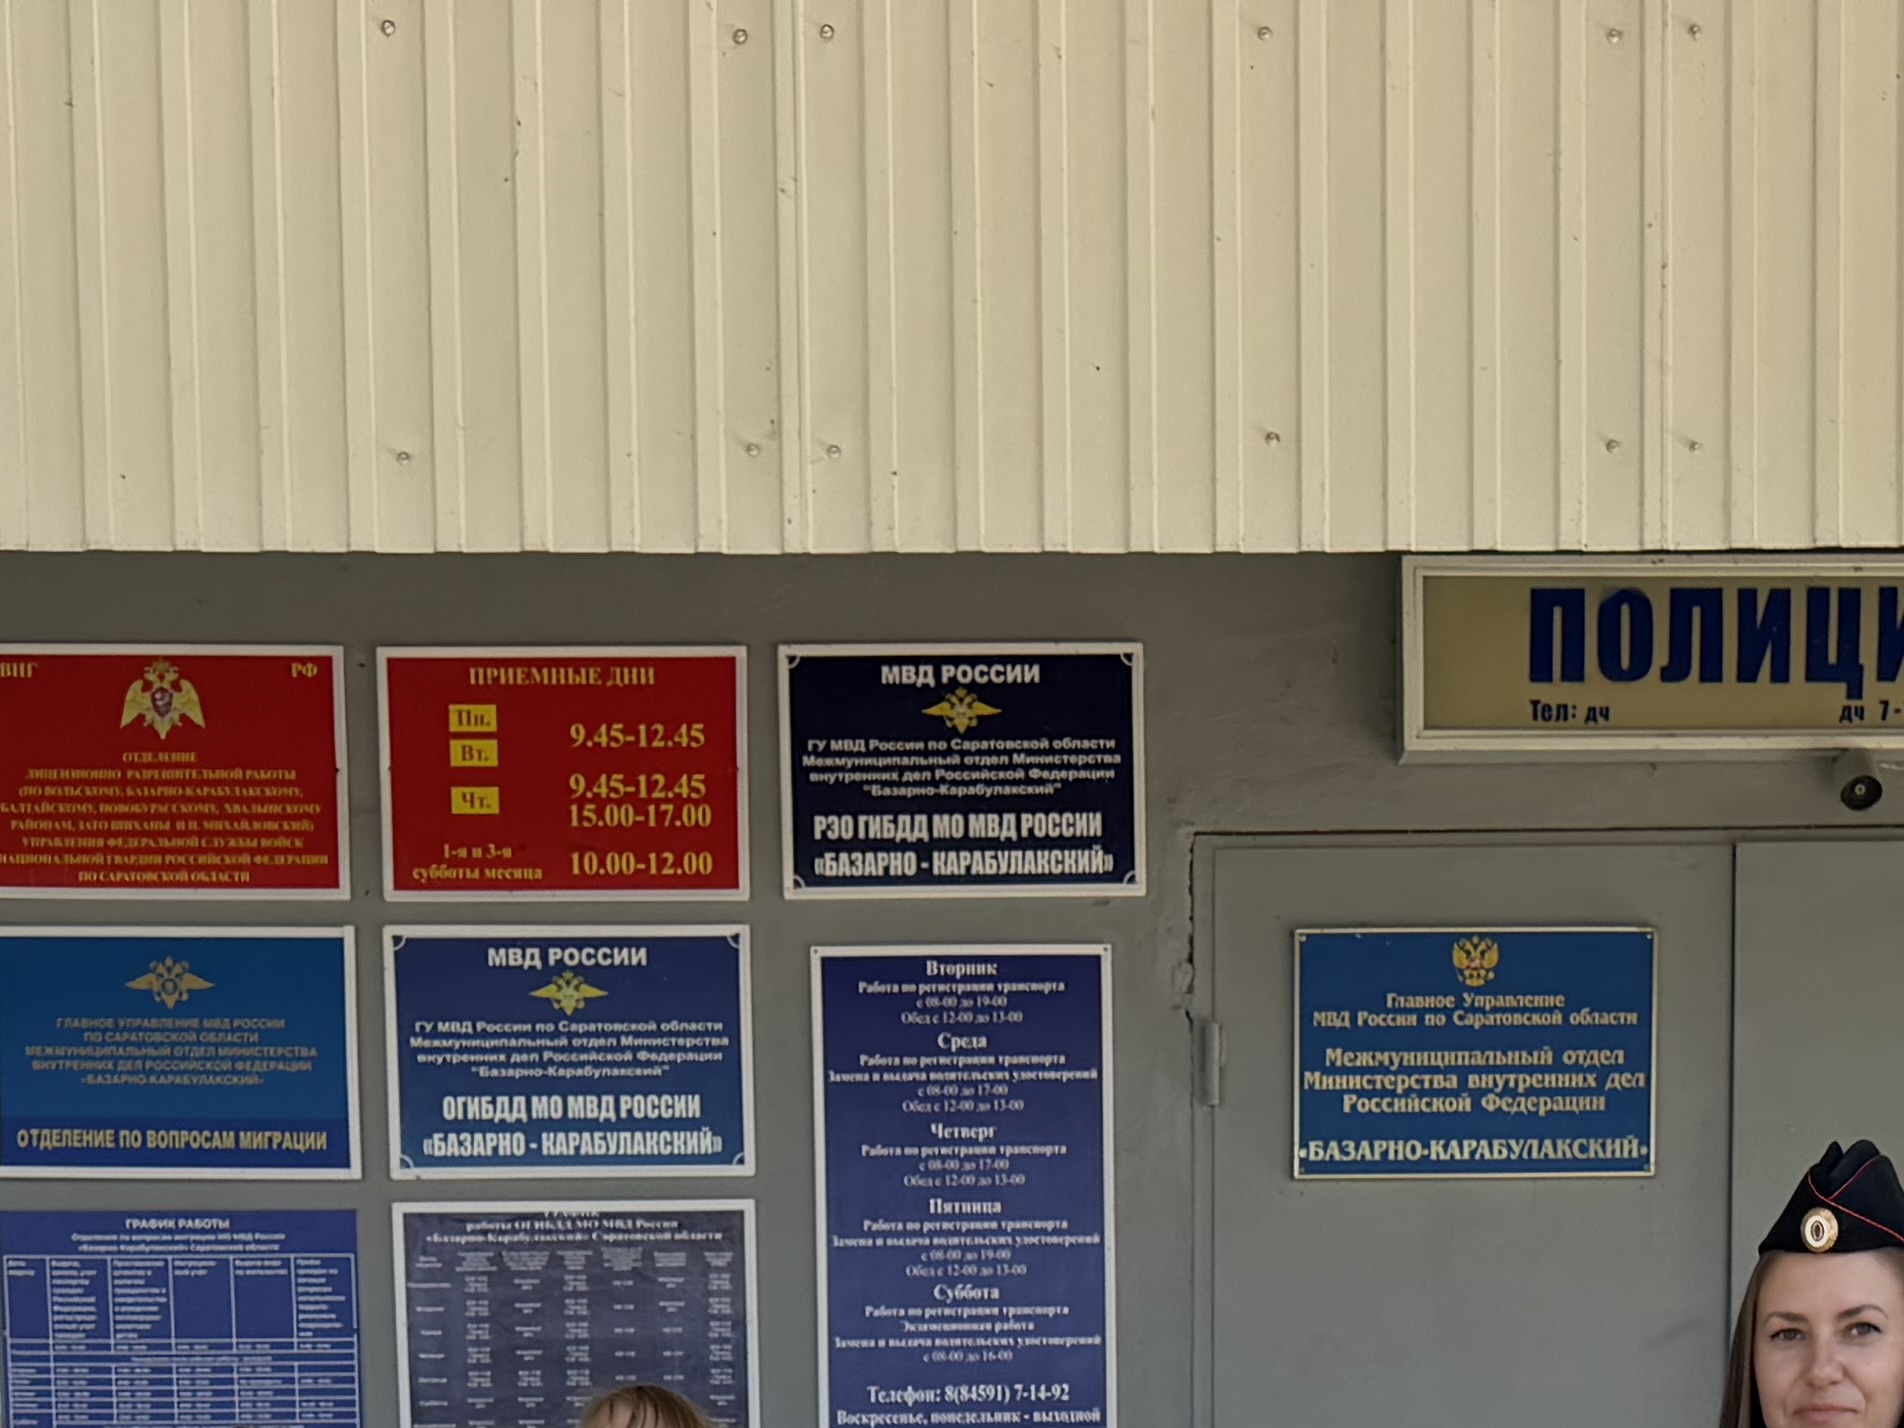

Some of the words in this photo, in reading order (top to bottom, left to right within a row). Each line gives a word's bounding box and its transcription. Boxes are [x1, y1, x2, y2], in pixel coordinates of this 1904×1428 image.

[0, 662, 37, 678] ВНГ
[291, 663, 318, 678] РФ
[470, 667, 601, 686] ПРИЕМНЫЕ
[607, 667, 655, 688] ДНИ
[882, 665, 935, 688] МВД
[942, 664, 1040, 683] РОССИИ
[457, 709, 491, 727] Пн.
[1530, 699, 1577, 722] Тел:
[1585, 705, 1609, 725] дч
[1840, 704, 1864, 725] дч
[570, 723, 705, 748] 9.45-12.45
[808, 740, 828, 752] ГУ
[831, 740, 865, 753] МВД
[869, 739, 924, 752] России
[928, 741, 947, 752] по
[951, 737, 1049, 752] Саратовской
[1053, 737, 1116, 751] области
[461, 745, 490, 762] Вт.
[802, 755, 961, 767] Межмуниципальный
[964, 755, 1009, 767] отдел
[1013, 752, 1121, 766] Министерства
[810, 770, 899, 783] внутренних
[902, 770, 932, 783] дел
[935, 768, 1025, 781] Российской
[1029, 768, 1115, 783] Федерации
[569, 773, 706, 798] 9.45-12.45
[461, 792, 491, 809] Чт.
[570, 804, 712, 827] 15.00-17.00
[814, 816, 854, 840] РЭО
[858, 814, 929, 842] ГИБДД
[933, 814, 964, 839] МО
[969, 814, 1017, 841] МВД
[1021, 812, 1102, 838] РОССИИ
[571, 852, 713, 875] 10.00-12.00
[815, 852, 916, 877] «БАЗАРНО
[933, 846, 1113, 875] КАРАБУЛАКСКИЙ»
[413, 864, 479, 883] субботы
[485, 867, 542, 880] месяца
[488, 948, 542, 969] МВД
[549, 947, 647, 966] РОССИИ
[926, 960, 997, 978] Вторник
[1386, 994, 1455, 1008] Главное
[1462, 993, 1565, 1010] Управление
[56, 1018, 114, 1029] ГЛАВНОЕ
[118, 1018, 200, 1029] УПРАВЛЕНИЕ
[204, 1018, 230, 1029] МВД
[233, 1018, 285, 1029] РОССИИ
[415, 1022, 434, 1033] ГУ
[438, 1022, 473, 1034] МВД
[477, 1021, 531, 1032] России
[536, 1023, 554, 1033] по
[558, 1021, 656, 1033] Саратовской
[661, 1020, 723, 1032] области
[1313, 1012, 1350, 1028] МВД
[1357, 1011, 1417, 1027] России
[1425, 1014, 1445, 1026] по
[1453, 1010, 1562, 1029] Саратовской
[1569, 1008, 1637, 1025] области
[84, 1032, 101, 1043] ПО
[104, 1032, 197, 1043] САРАТОВСКОЙ
[200, 1032, 259, 1043] ОБЛАСТИ
[410, 1037, 568, 1049] Межмуниципальный
[572, 1037, 616, 1048] отдел
[621, 1036, 729, 1048] Министерства
[937, 1032, 987, 1051] Среда
[25, 1046, 170, 1057] МЕЖМУНИЦИПАЛЬНЫЙ
[174, 1046, 216, 1057] ОТДЕЛ
[219, 1046, 317, 1057] МИНИСТЕРСТВА
[417, 1052, 506, 1064] внутренних
[510, 1052, 538, 1063] дел
[544, 1050, 632, 1062] Российской
[637, 1050, 723, 1063] Федерации
[1325, 1047, 1552, 1069] Межмуниципальный
[1563, 1049, 1624, 1066] отдел
[33, 1060, 114, 1071] ВНУТРЕННИХ
[117, 1060, 142, 1071] ДЕЛ
[145, 1060, 232, 1071] РОССИЙСКОЙ
[235, 1060, 312, 1071] ФЕДЕРАЦИИ
[1304, 1073, 1457, 1093] Министерства
[1468, 1074, 1596, 1092] внутренних
[1605, 1073, 1645, 1091] дел
[443, 1096, 527, 1123] ОГИБДД
[532, 1096, 562, 1119] МО
[567, 1095, 616, 1122] МВД
[621, 1094, 700, 1119] РОССИИ
[1343, 1094, 1472, 1113] Российской
[1481, 1095, 1605, 1116] Федерации
[17, 1129, 114, 1150] ОТДЕЛЕНИЕ
[120, 1130, 142, 1149] ПО
[146, 1130, 235, 1150] ВОПРОСАМ
[240, 1131, 327, 1152] МИГРАЦИИ
[424, 1132, 526, 1156] «БАЗАРНО
[542, 1127, 722, 1156] КАРАБУЛАКСКИЙ»
[930, 1123, 997, 1141] Четверг
[929, 1199, 1002, 1216] Пятница
[933, 1284, 999, 1303] Суббота
[868, 1386, 941, 1406] Телефон:
[945, 1385, 1010, 1405] 8(84591)
[1015, 1385, 1069, 1402] 7-14-92
[837, 1410, 927, 1427] Воскресенье,
[930, 1411, 1020, 1427] понедельник
[1033, 1407, 1100, 1424] выходной
